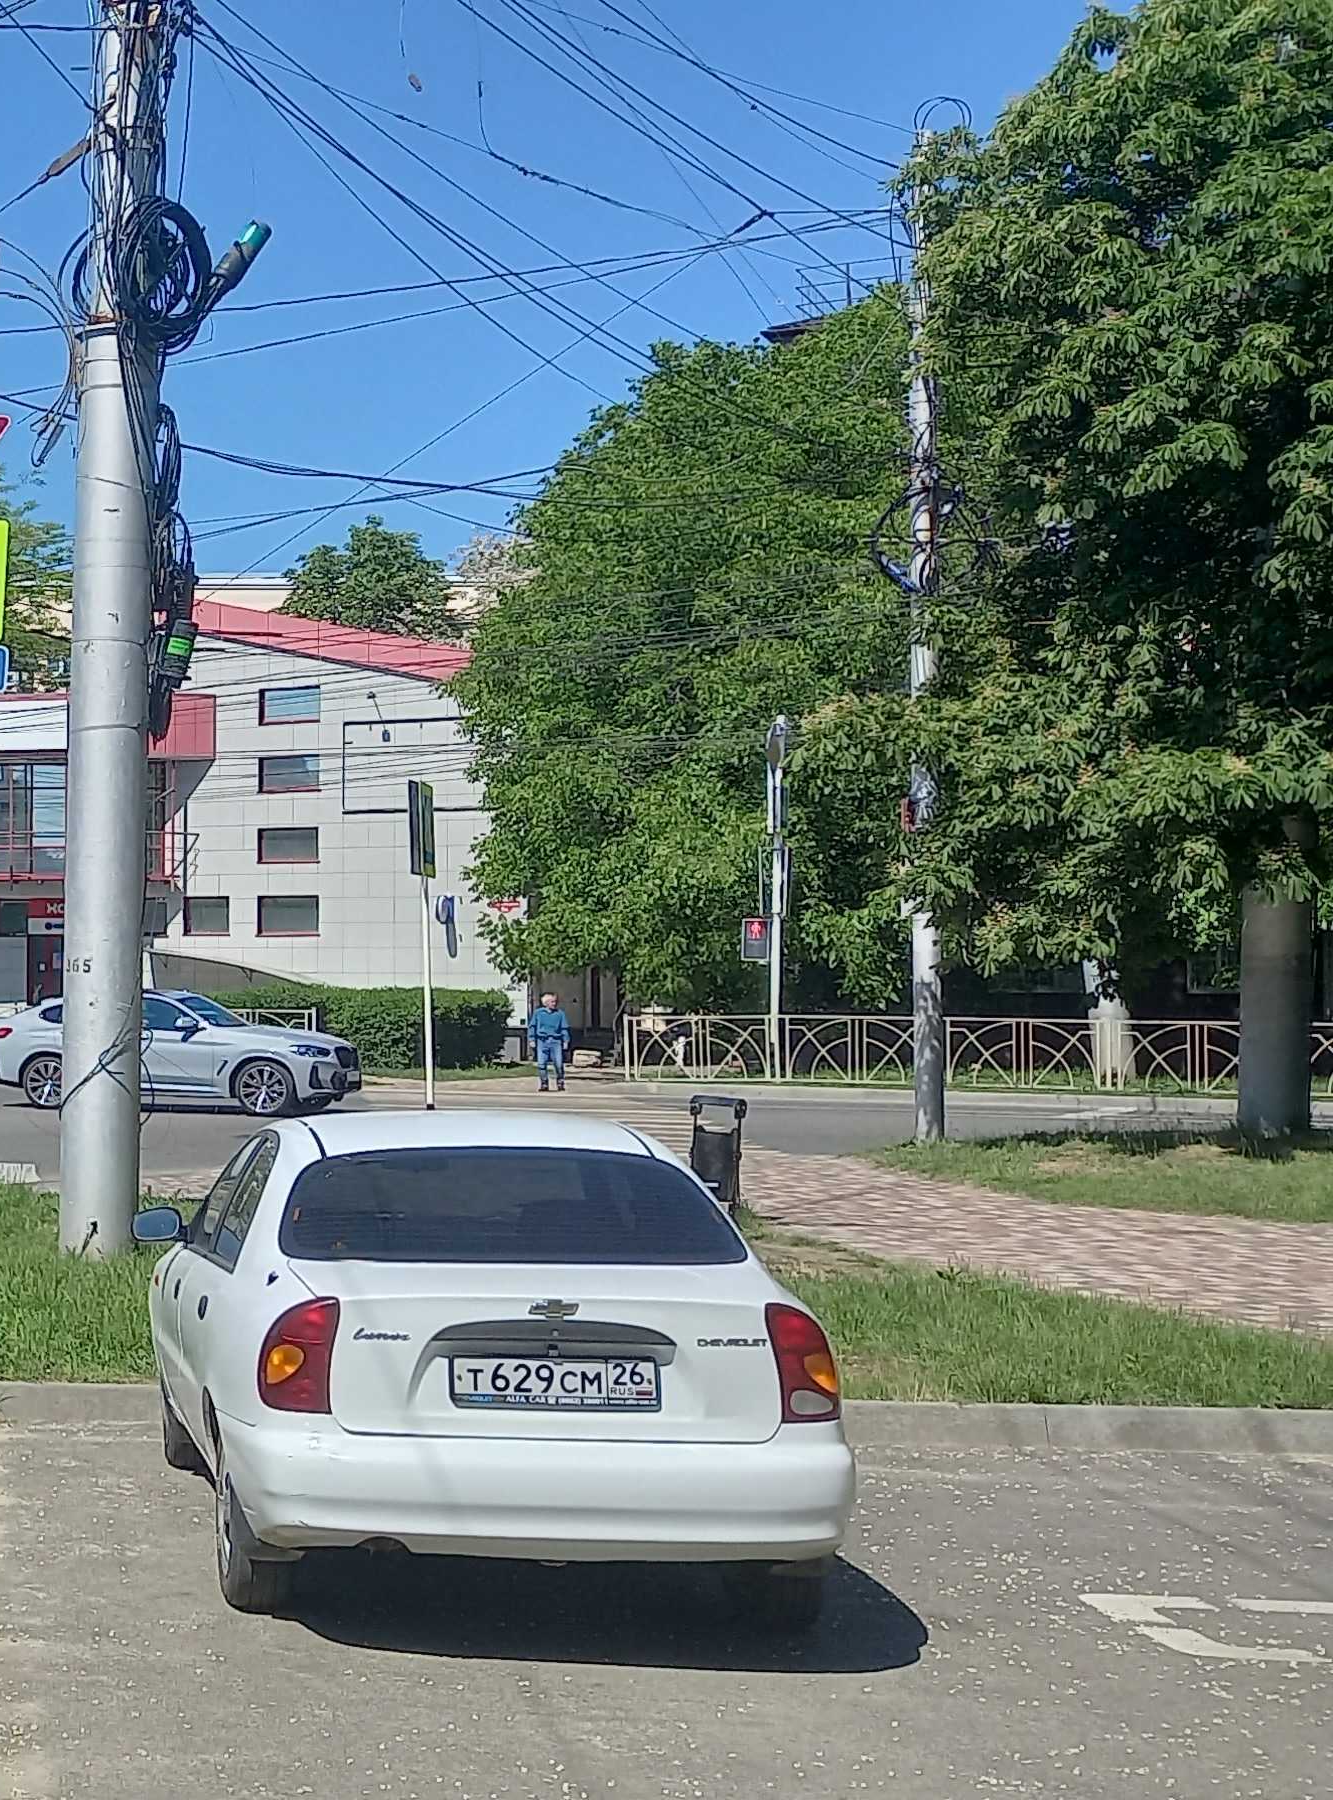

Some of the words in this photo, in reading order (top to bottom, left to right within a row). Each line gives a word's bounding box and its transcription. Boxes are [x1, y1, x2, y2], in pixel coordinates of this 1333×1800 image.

[466, 1362, 603, 1395] Т629СМ
[612, 1362, 645, 1386] 26
[609, 1386, 634, 1396] RUS
